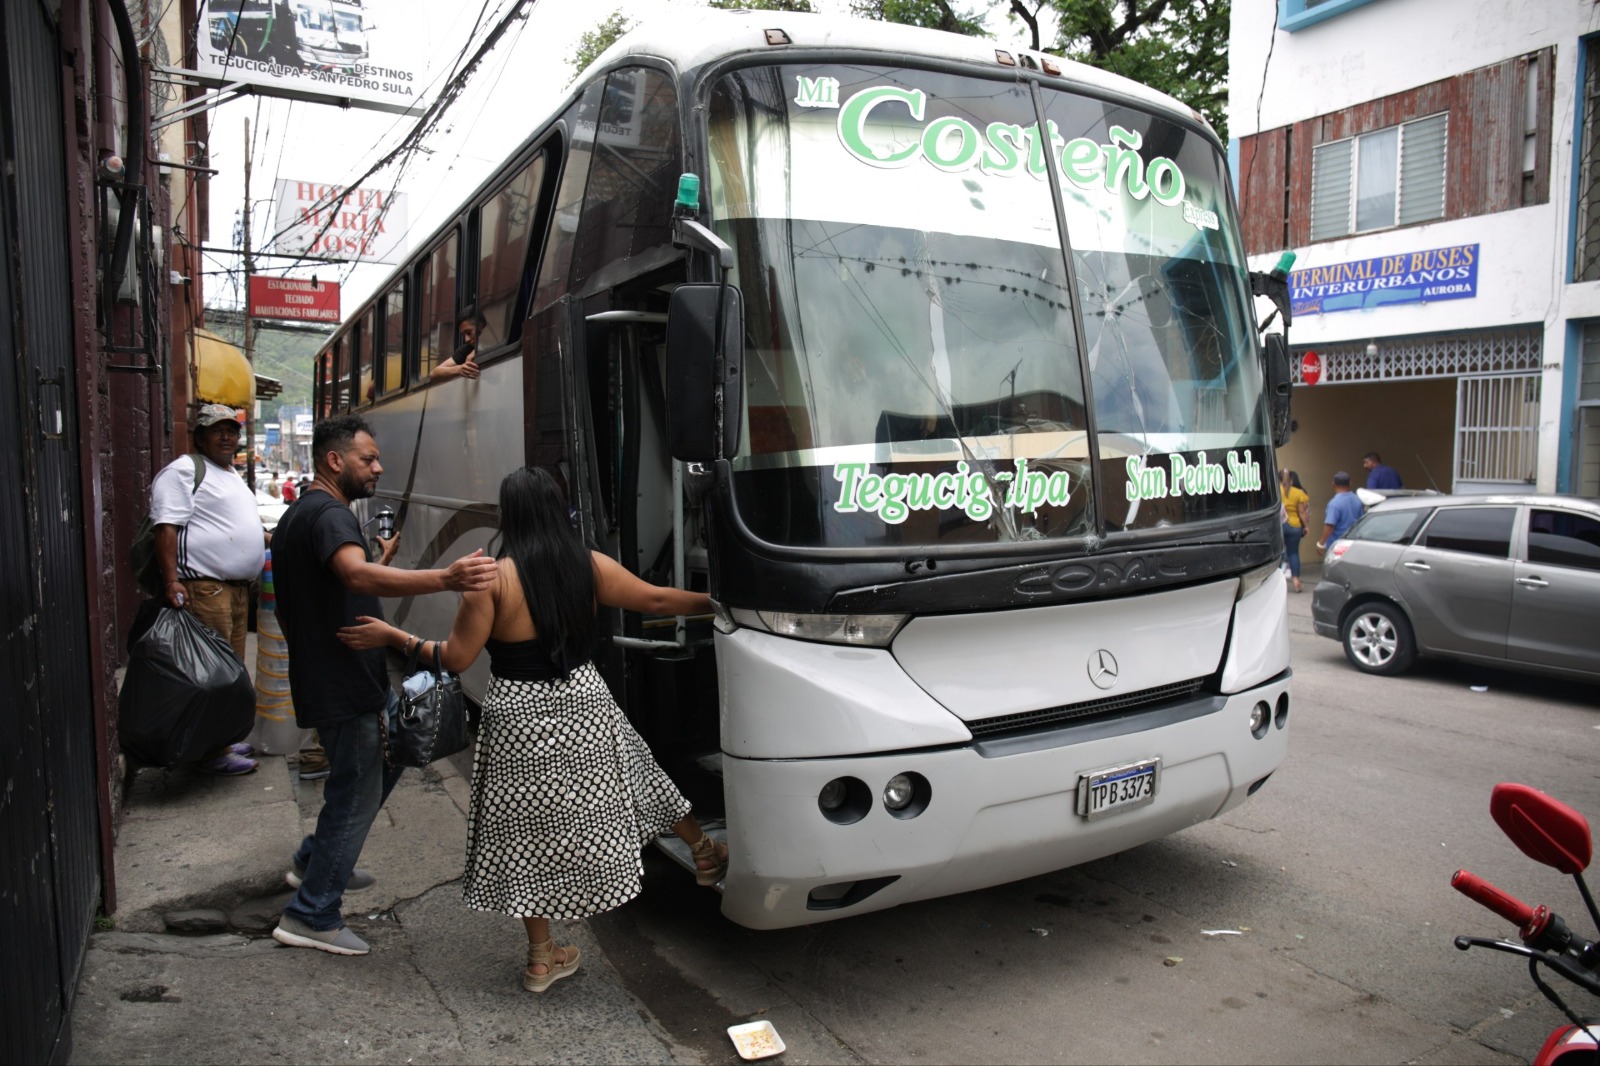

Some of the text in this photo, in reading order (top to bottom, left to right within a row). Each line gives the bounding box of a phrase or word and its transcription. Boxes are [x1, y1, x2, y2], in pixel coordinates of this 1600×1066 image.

[209, 54, 300, 78] TEGUCIGALPA
[310, 70, 337, 84] SAN
[339, 74, 379, 91] PEDRO
[382, 83, 413, 96] SULA
[354, 63, 414, 82] DESTINOS
[839, 87, 1184, 204] Costeño
[1291, 245, 1474, 288] TERMINAL DE BUSES
[1292, 266, 1471, 299] INTERURBANOS
[284, 294, 315, 305] TECHADO
[1424, 283, 1471, 296] AURORA
[255, 305, 338, 319] HABITACIONES FAMILIARES
[1126, 456, 1167, 500] San
[1170, 451, 1225, 496] Pedro
[1227, 450, 1261, 492] Sula
[1091, 782, 1118, 810] TPB
[1120, 774, 1152, 801] 3373
